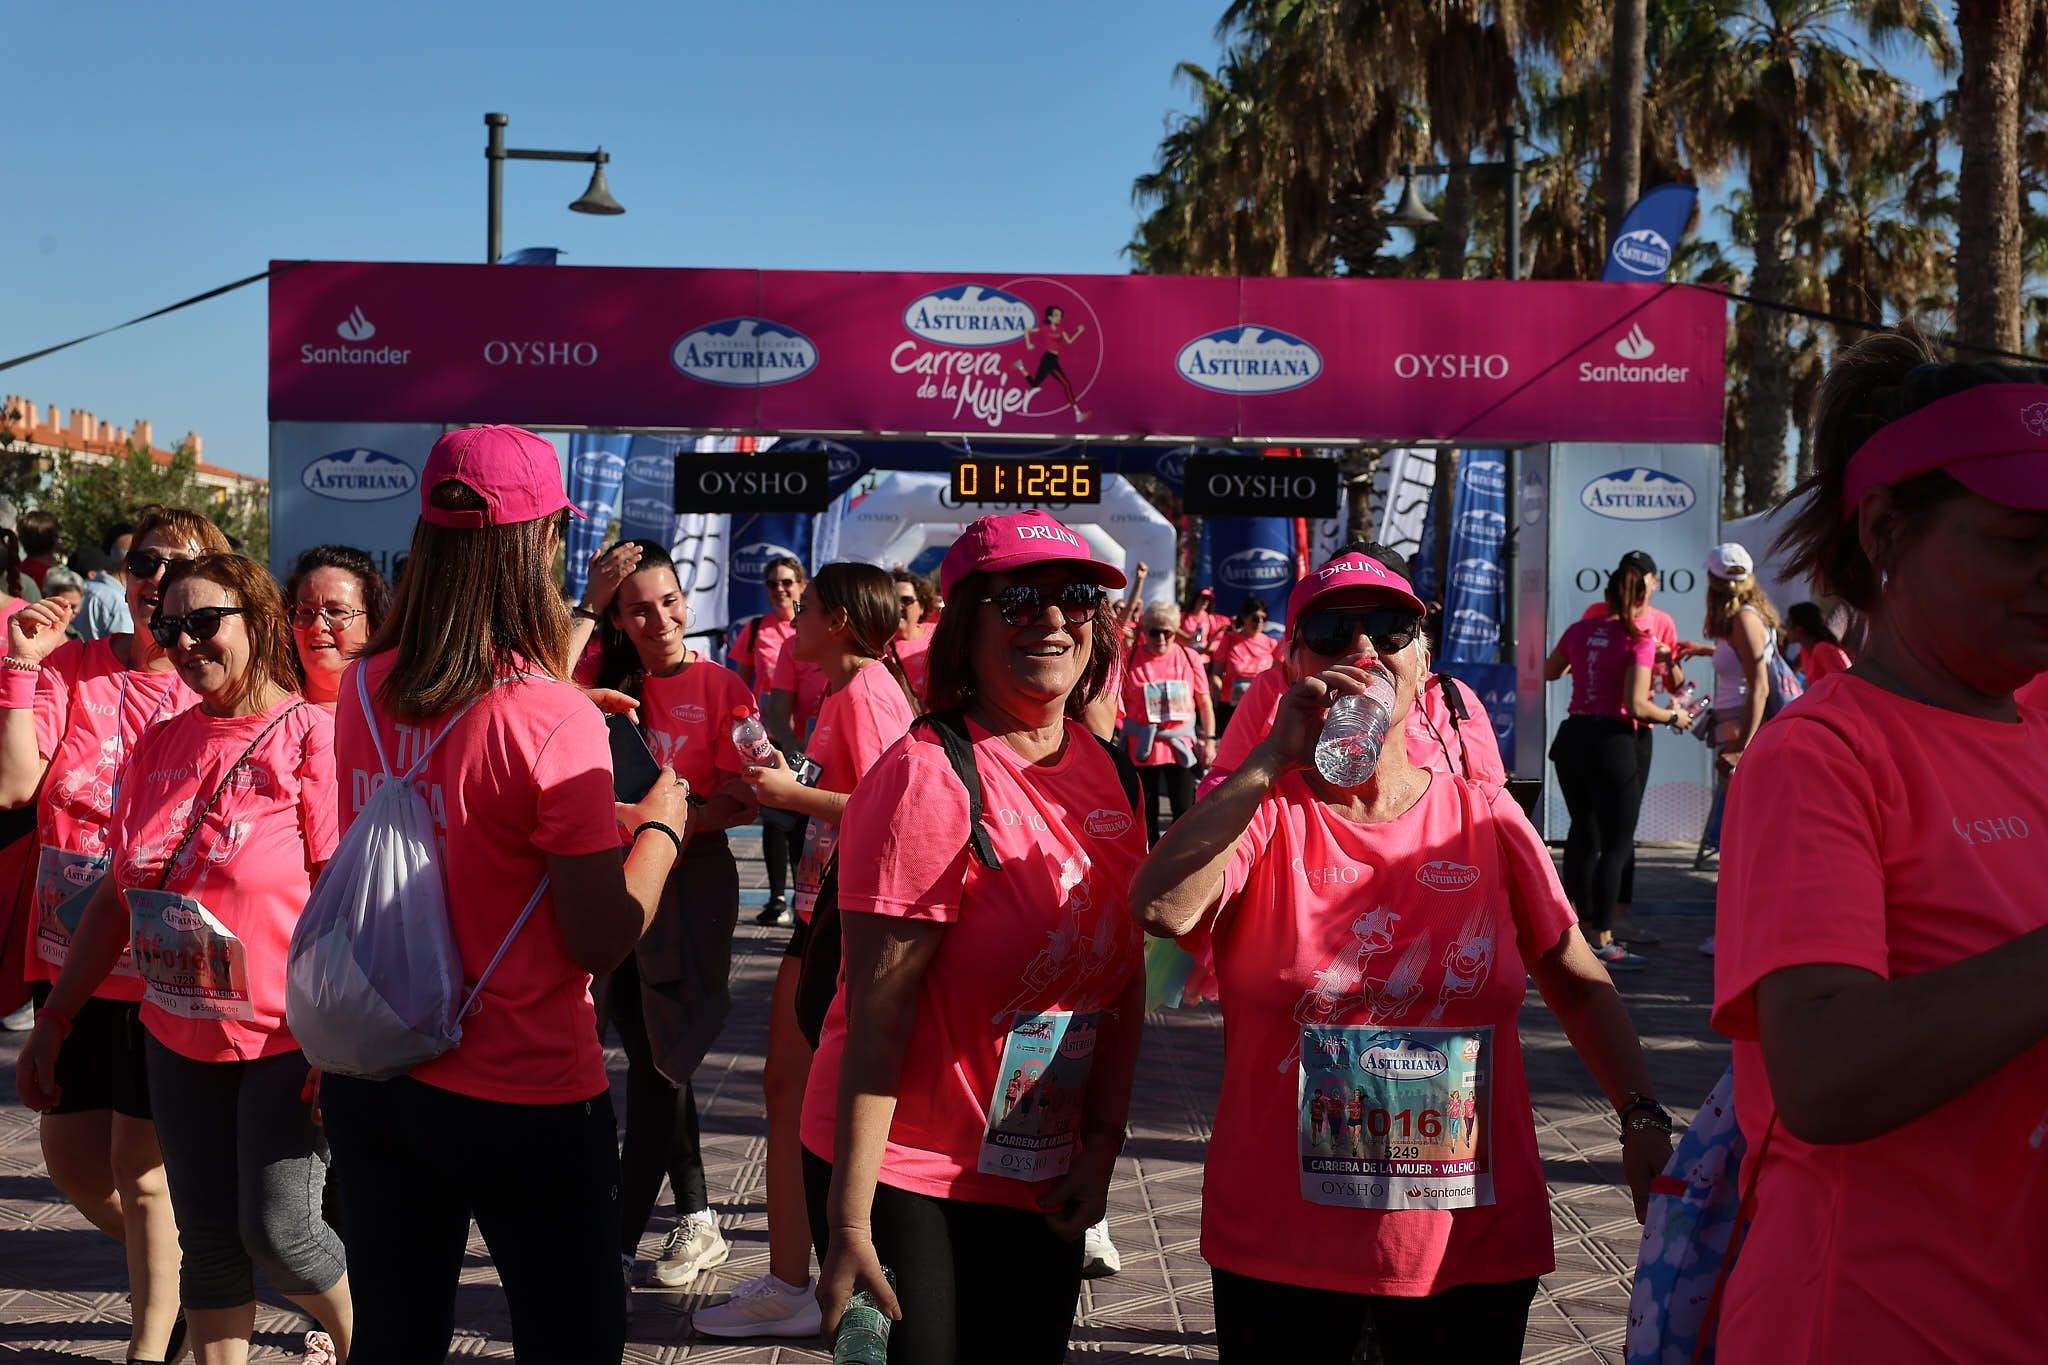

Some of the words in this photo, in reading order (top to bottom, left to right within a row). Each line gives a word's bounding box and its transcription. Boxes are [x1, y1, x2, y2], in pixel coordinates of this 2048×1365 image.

[914, 306, 1026, 331] ASTURIANA
[301, 344, 411, 366] Santander
[483, 341, 598, 368] OYSHO
[683, 342, 806, 369] ASTURIANA
[890, 340, 1002, 376] Carrera
[1188, 350, 1310, 376] ASTURIANA
[1394, 353, 1510, 380] OYSHO
[1579, 361, 1690, 384] Santander
[917, 376, 938, 399] de
[942, 376, 957, 400] la
[953, 372, 1042, 428] Mujer
[312, 468, 409, 489] ASTURIANA
[699, 471, 808, 495] OYSHO
[1208, 474, 1316, 499] OYSHO
[1590, 487, 1687, 508] ASTURIANA
[1017, 525, 1080, 548] DRUNI
[1319, 561, 1386, 581] DRUNI
[393, 723, 431, 774] TU
[1422, 869, 1477, 885] ASTURIANA
[173, 975, 196, 985] 1720
[209, 989, 242, 999] VALENCIA
[1365, 1053, 1442, 1071] ASTURIANA
[1367, 1109, 1442, 1138] 016
[995, 1133, 1041, 1149] CARRERA
[1384, 1146, 1419, 1159] 5249
[1311, 1159, 1360, 1173] CARRERA
[1362, 1162, 1377, 1173] DE
[1379, 1162, 1393, 1174] LA
[1396, 1163, 1432, 1175] MUJER
[1441, 1161, 1481, 1175] VALENCIA
[1321, 1181, 1384, 1197] OYSHO
[1423, 1184, 1476, 1199] Santander
